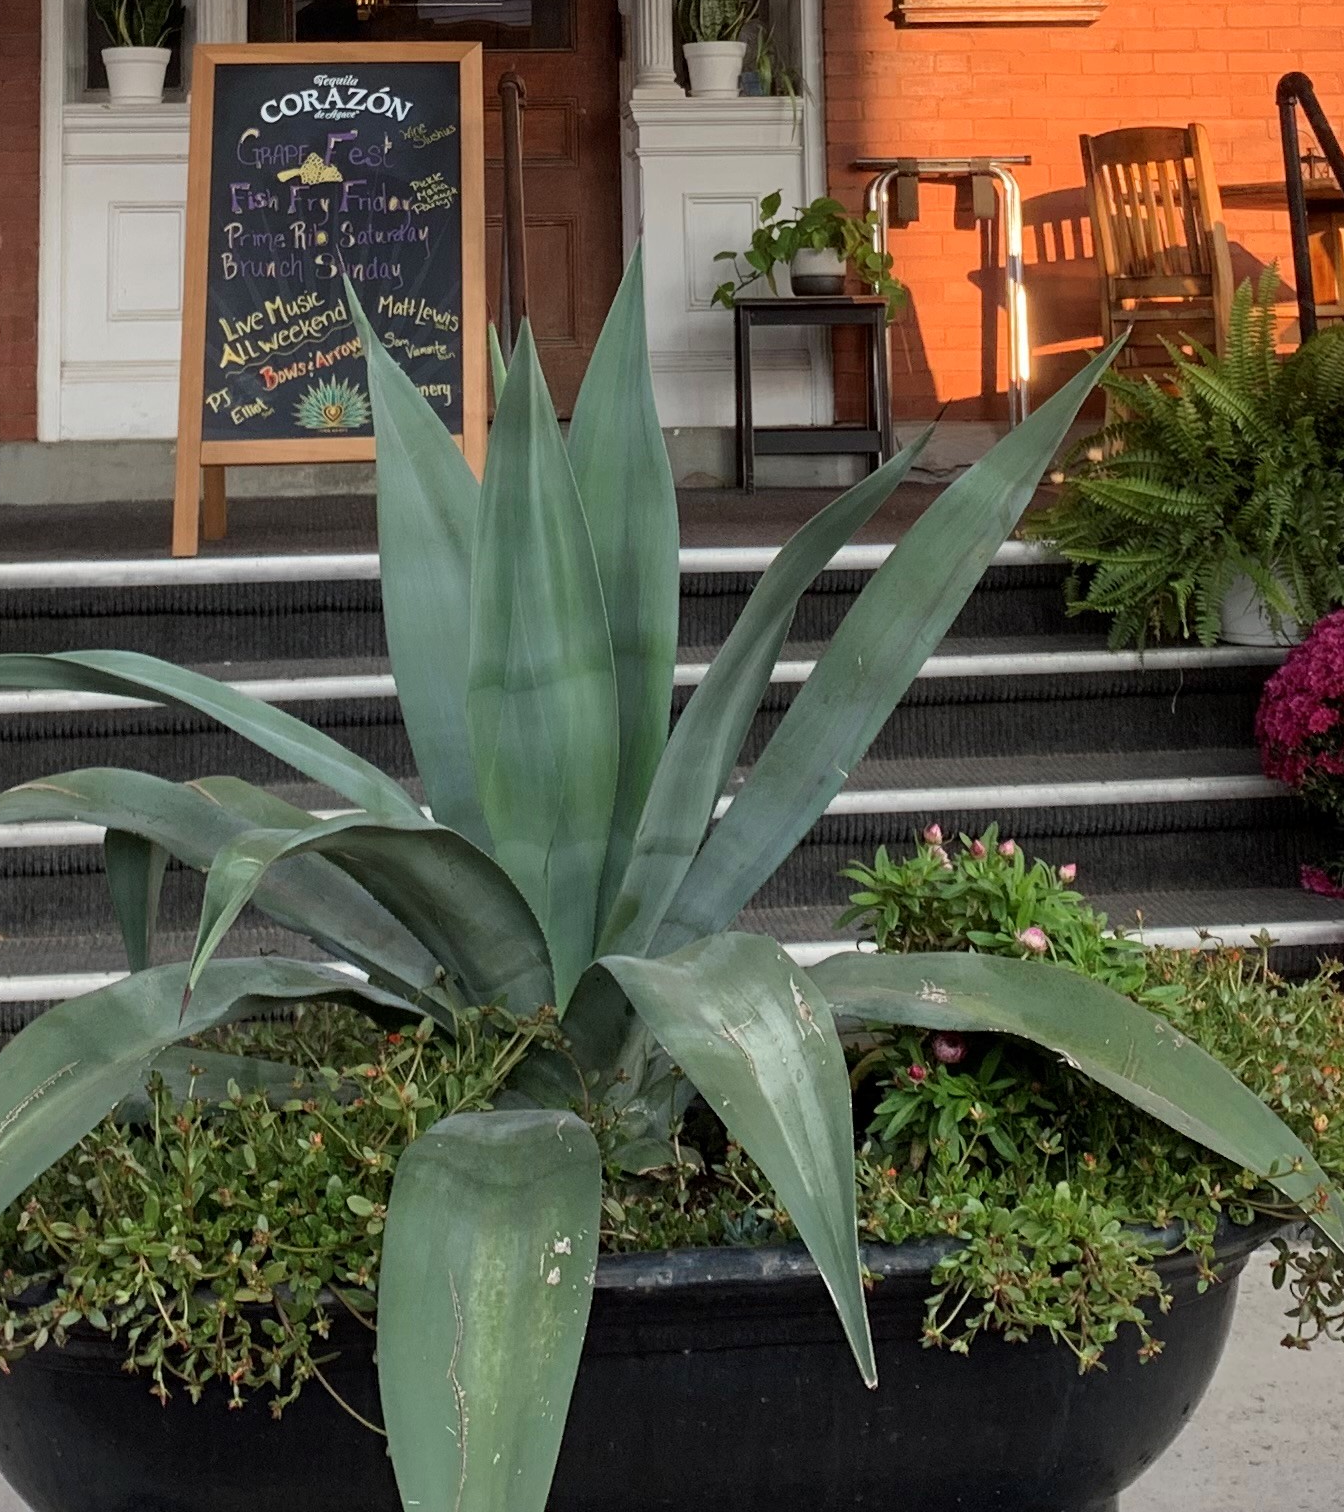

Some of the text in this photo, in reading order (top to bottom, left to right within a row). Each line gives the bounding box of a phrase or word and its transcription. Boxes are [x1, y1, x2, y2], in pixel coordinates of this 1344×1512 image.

[313, 74, 359, 88] Tequila
[260, 86, 414, 123] CORAZÓN
[323, 129, 396, 168] Fest
[230, 179, 413, 229] Fish Fry Friday
[224, 221, 431, 260] Prime Rib Saturday
[221, 252, 304, 283] Brunch
[219, 290, 325, 342] Live Music
[258, 298, 348, 354] weekend
[415, 298, 459, 332] Lewis
[259, 362, 307, 391] Bows
[205, 387, 232, 414] PJ
[418, 383, 453, 407] nery
